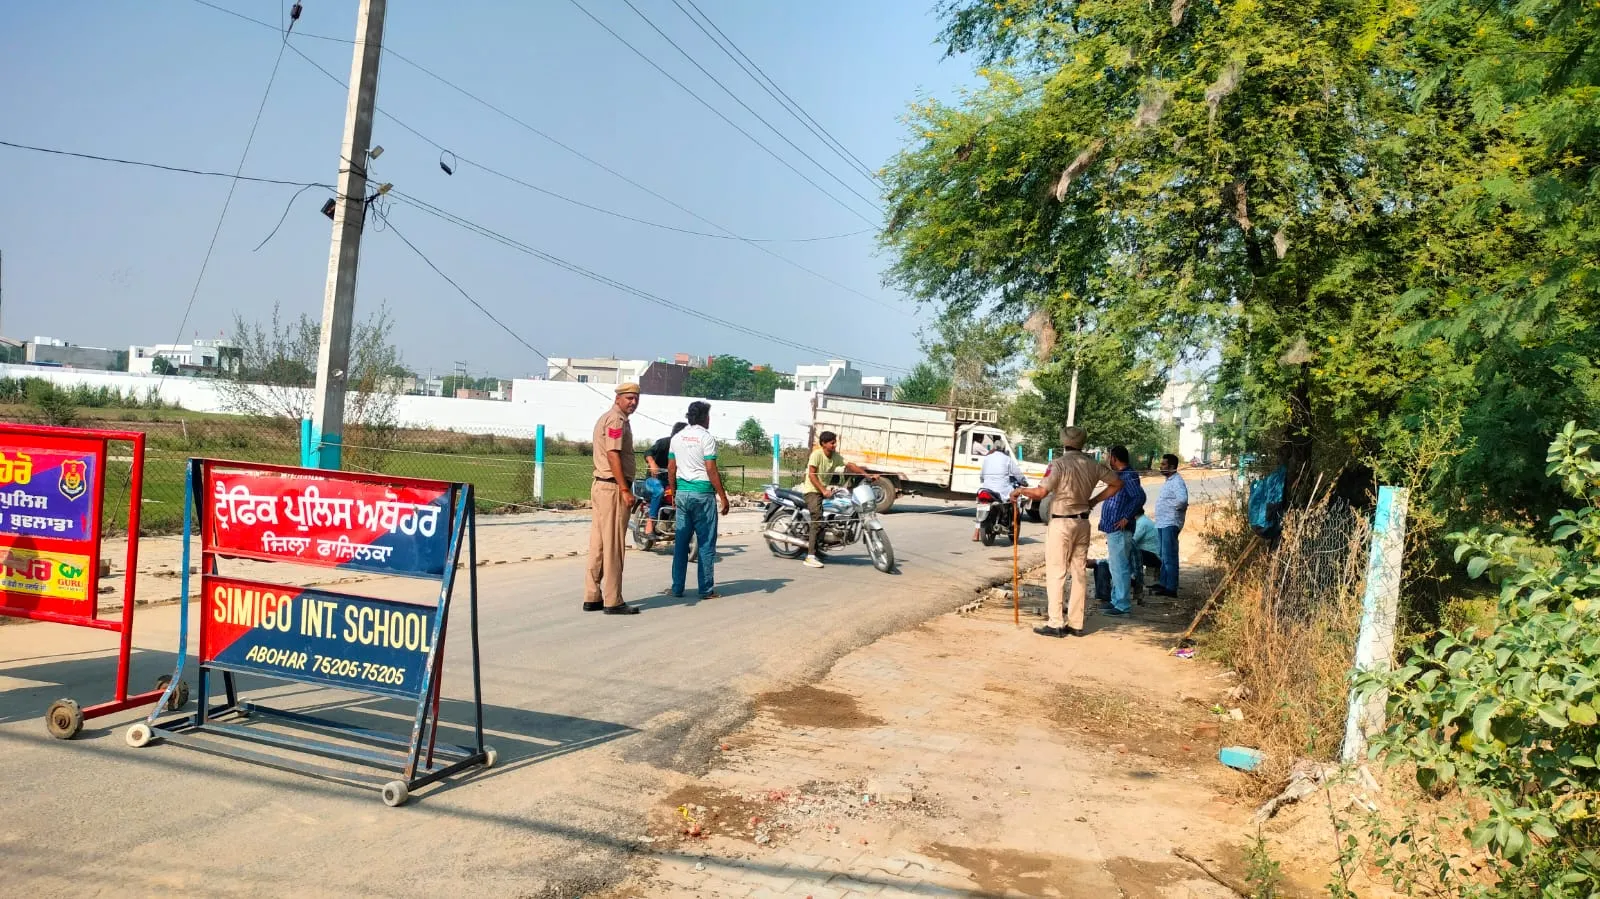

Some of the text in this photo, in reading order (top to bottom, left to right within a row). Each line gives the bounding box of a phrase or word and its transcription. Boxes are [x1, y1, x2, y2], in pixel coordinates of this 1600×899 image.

[0, 490, 47, 509] ਪੁਲਿਸ
[215, 481, 441, 537] ਟ੍ਰੈਫਿਕ ਪੁਲਿਸ ਅਬੋਹਰ
[317, 535, 393, 562] ਫਾਜ਼ਿਲਕਾ
[214, 586, 432, 652] SIMIGO INT. SCHOOL
[246, 645, 307, 670] ABOHAR
